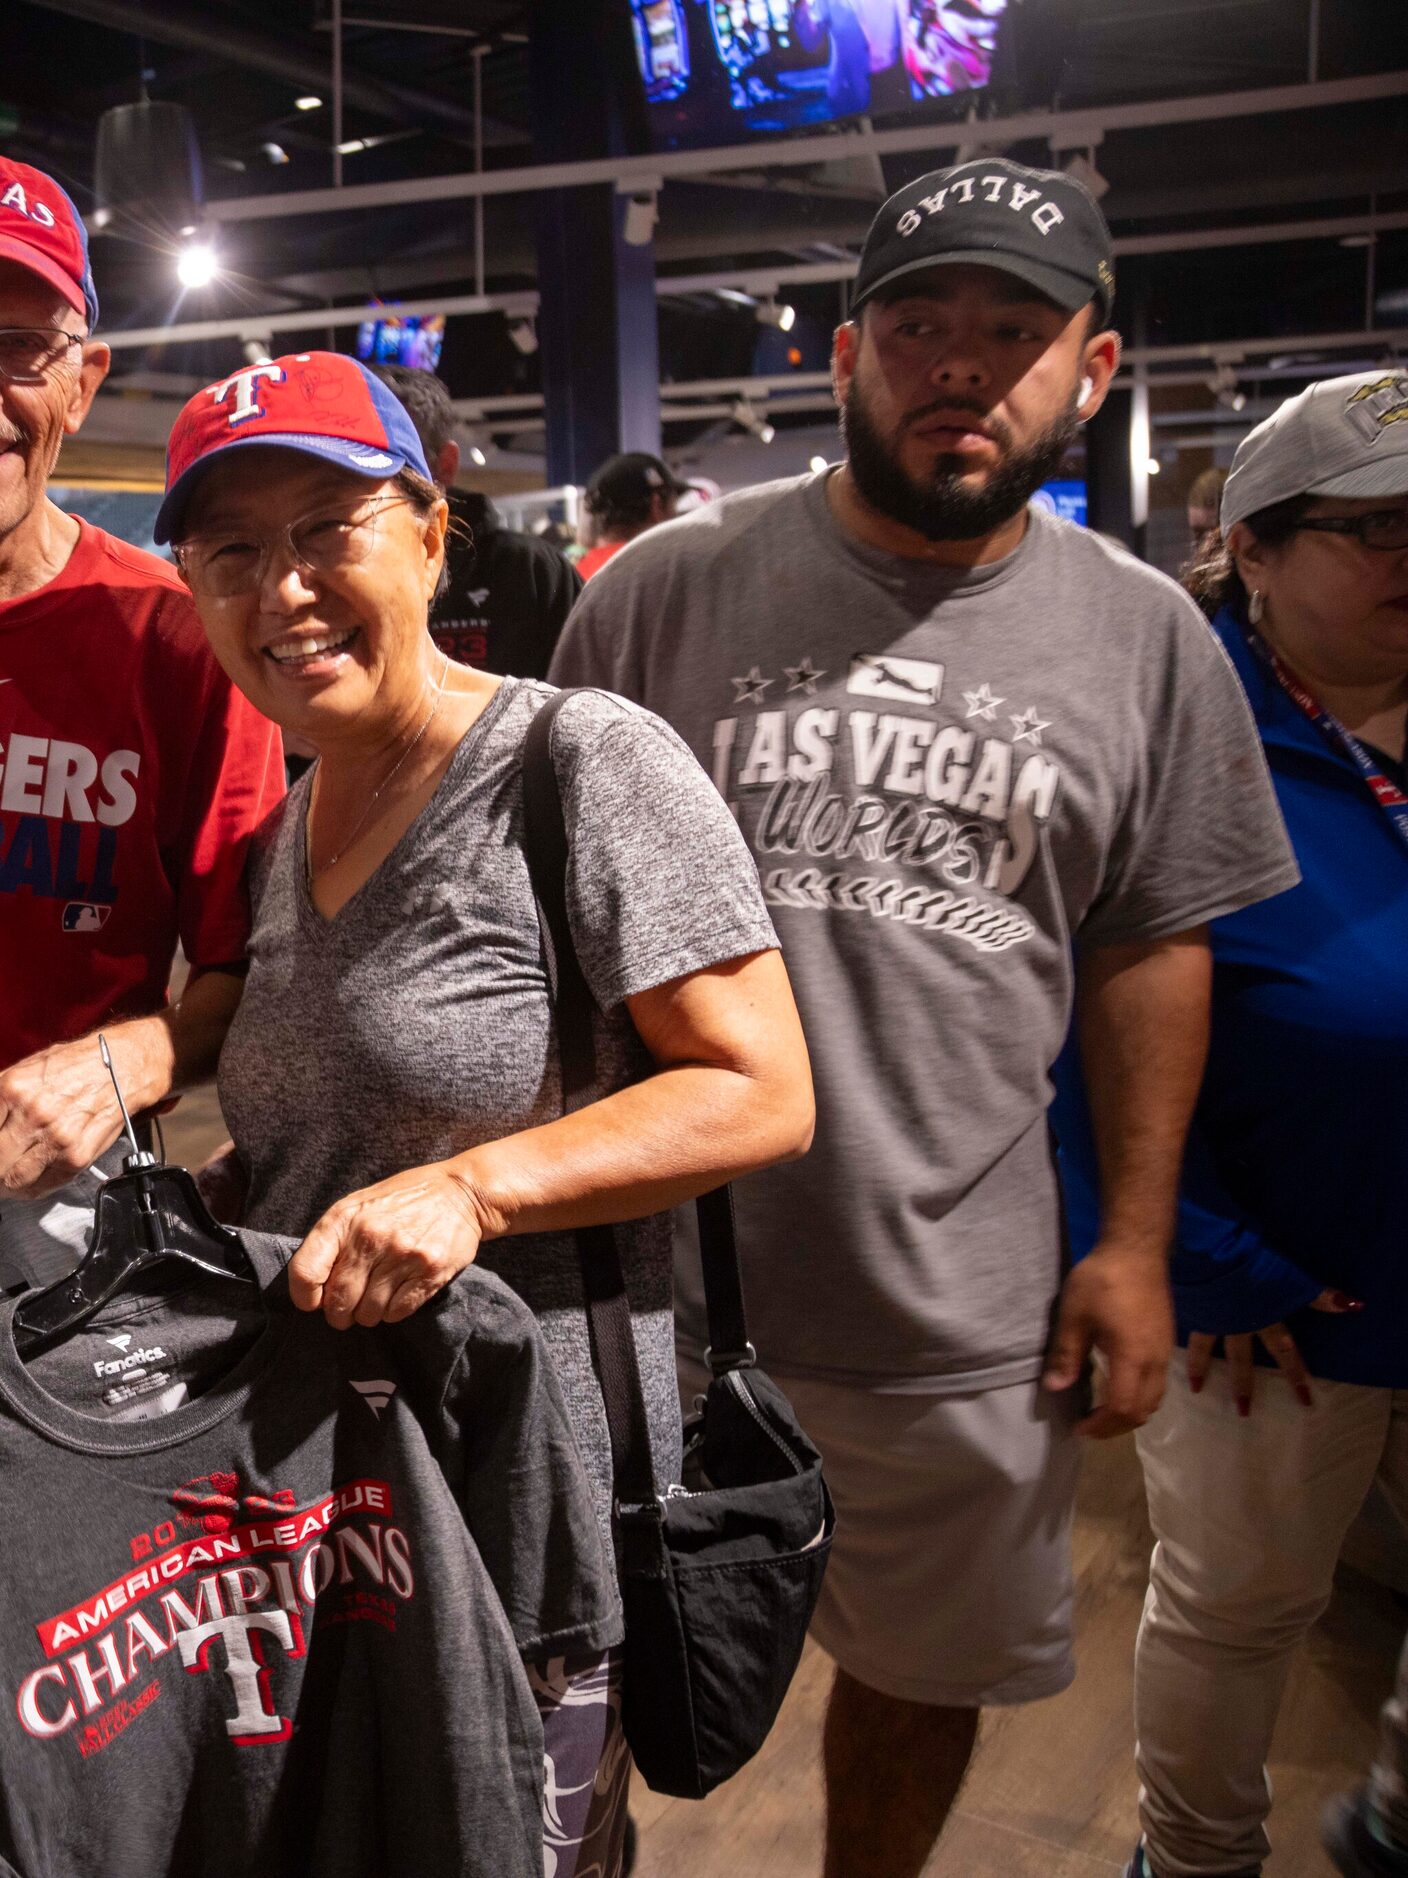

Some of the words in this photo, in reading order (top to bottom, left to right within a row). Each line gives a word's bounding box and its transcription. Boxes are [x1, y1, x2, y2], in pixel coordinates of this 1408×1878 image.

[896, 175, 1064, 238] DALLAS
[206, 365, 287, 428] T
[848, 710, 1060, 896] VEGAS
[17, 1524, 415, 1740] CHAMPIONS
[52, 1534, 241, 1650] AMERICAN
[250, 1484, 385, 1549] LEAGUE
[178, 1609, 305, 1748] T
